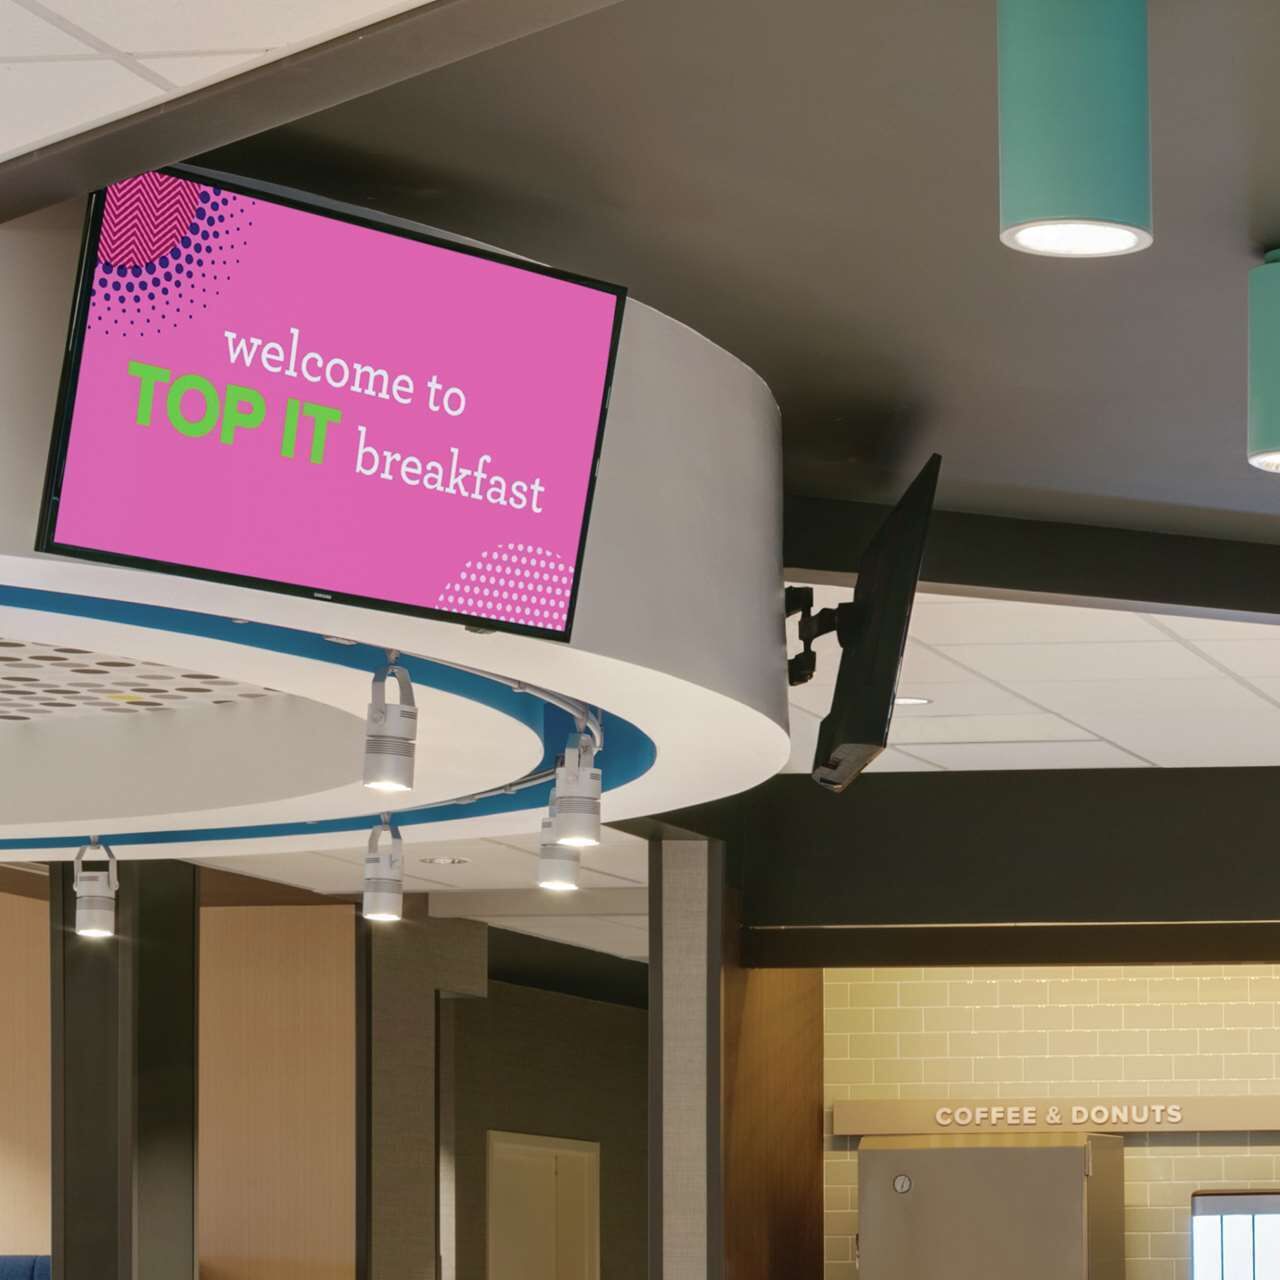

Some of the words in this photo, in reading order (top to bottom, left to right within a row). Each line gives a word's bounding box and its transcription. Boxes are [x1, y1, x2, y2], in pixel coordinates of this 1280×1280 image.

[224, 328, 415, 404] welcome
[427, 374, 466, 416] to
[128, 360, 266, 445] TOP
[281, 398, 343, 464] IT
[355, 426, 545, 513] breakfast
[935, 1105, 1037, 1126] COFFEE
[1046, 1105, 1063, 1125] &
[1071, 1104, 1183, 1125] DONUTS
